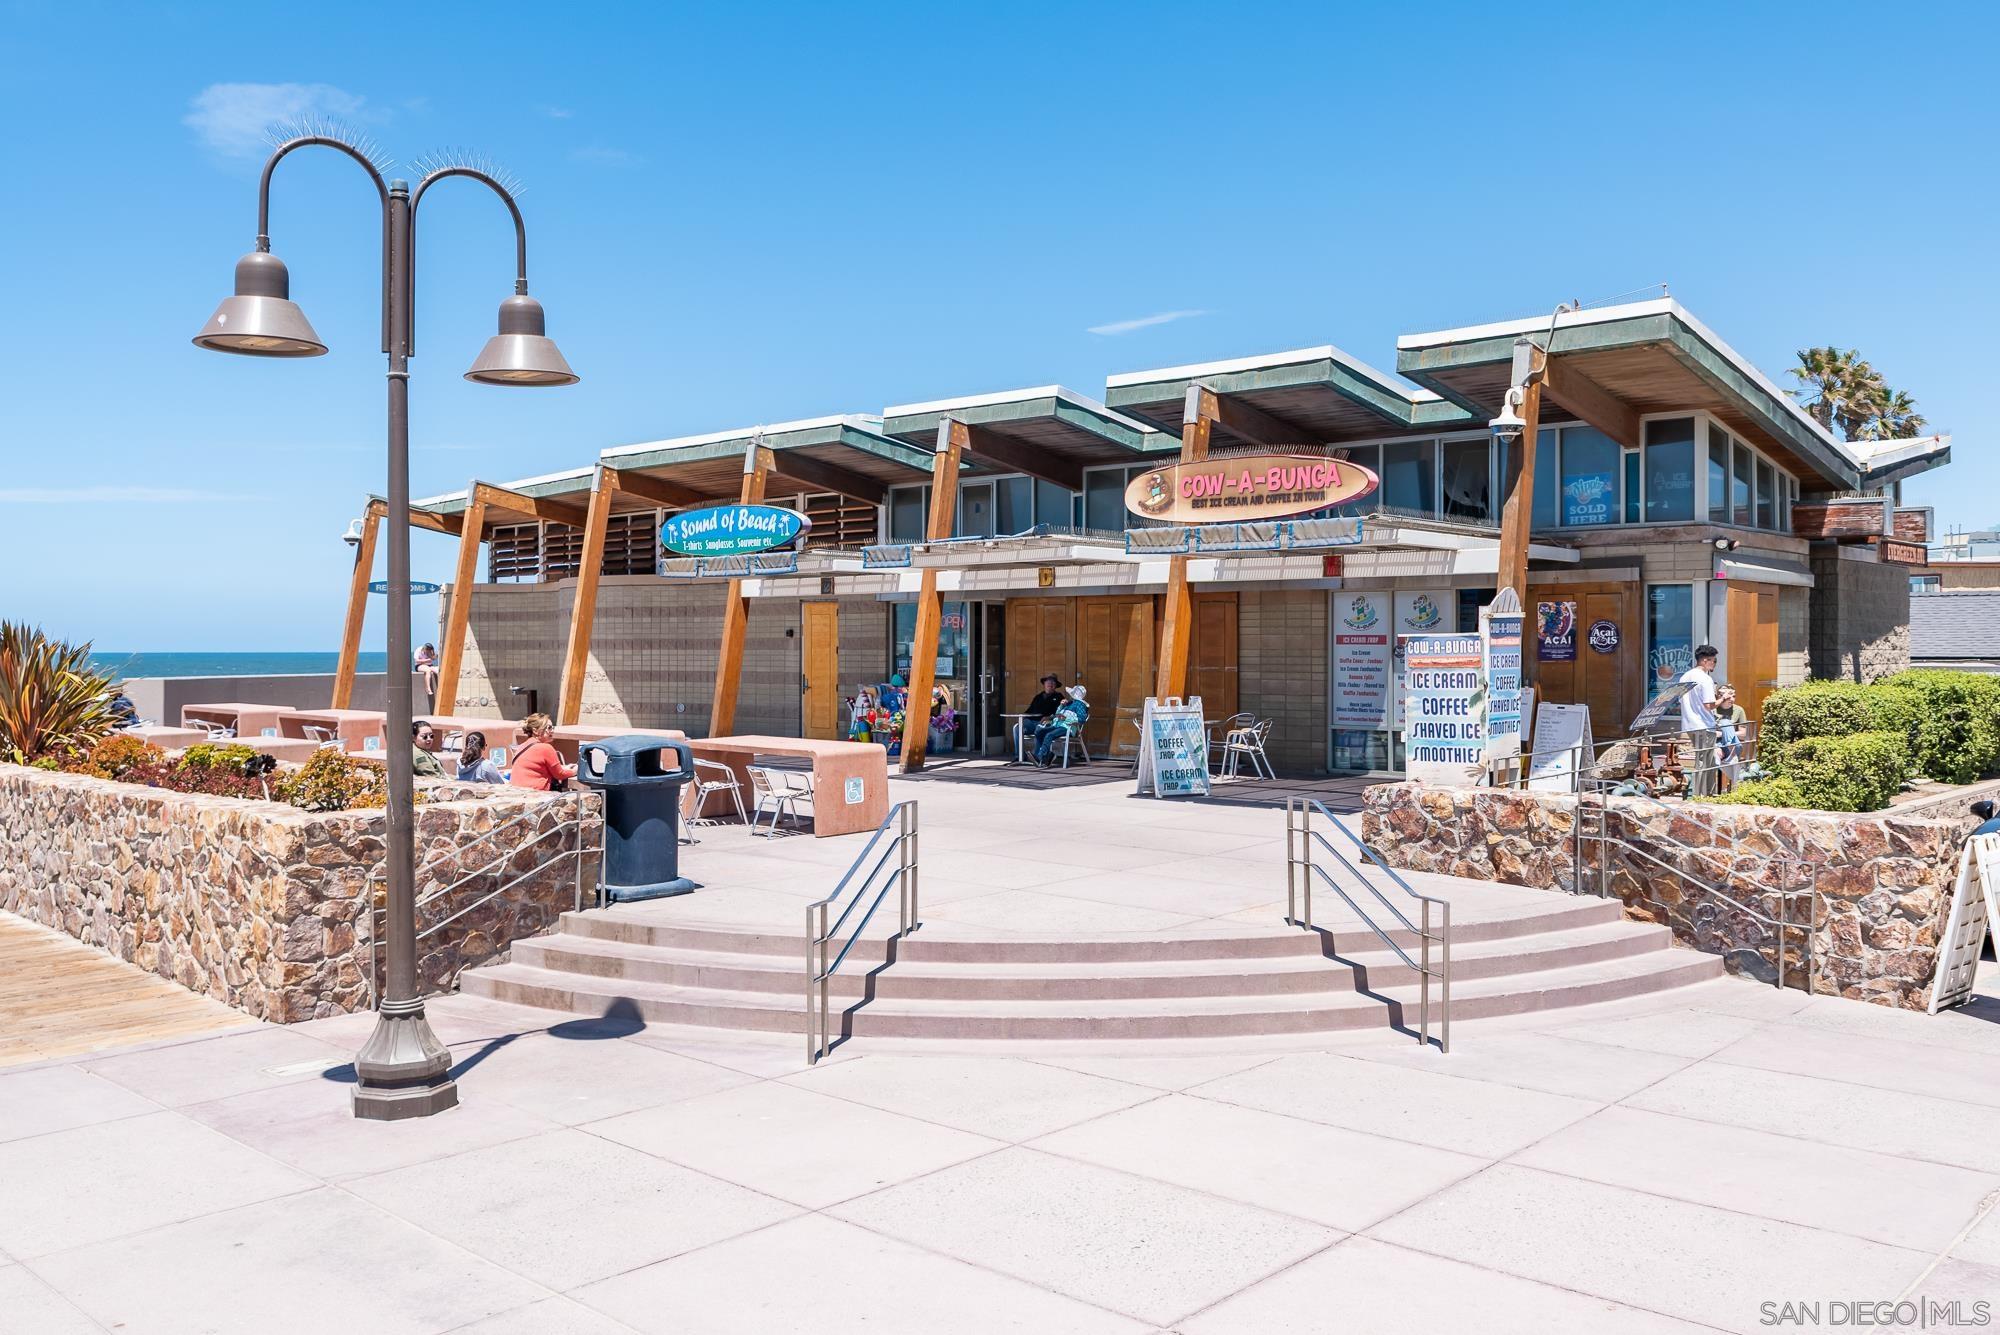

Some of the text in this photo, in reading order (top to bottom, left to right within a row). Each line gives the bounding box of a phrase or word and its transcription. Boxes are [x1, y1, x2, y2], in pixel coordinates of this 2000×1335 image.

[1180, 463, 1342, 497] COW-A-BUNGA
[1191, 490, 1326, 509] BEST ICE CREAM AND COFFEE IN TOWN
[1569, 504, 1607, 515] SOLD
[681, 508, 777, 539] Sound of Beach
[1568, 514, 1607, 525] HERE
[682, 540, 703, 551] T-shirts
[705, 539, 734, 550] Sunglasses
[737, 536, 761, 548] Souvenir
[1490, 622, 1521, 633] COW-A-BUNGA
[1407, 640, 1481, 654] COW-A-BUNGA
[1490, 655, 1500, 669] ICE
[1500, 654, 1520, 668] CREAM
[1413, 672, 1477, 689] ICE CREAM
[1495, 675, 1515, 691] COFFEE
[1422, 697, 1468, 716] COFFEE
[1489, 699, 1510, 713] SHAVED
[1510, 698, 1520, 712] ICE
[1412, 722, 1481, 739] SHAVED ICE
[1489, 719, 1521, 736] SMOOTHIES
[1158, 738, 1184, 749] COFFEE
[1160, 751, 1175, 760] SHOP
[1412, 746, 1481, 763] SMOOTHIES
[1162, 767, 1202, 780] ICE CREAM
[1163, 782, 1179, 791] SHOP
